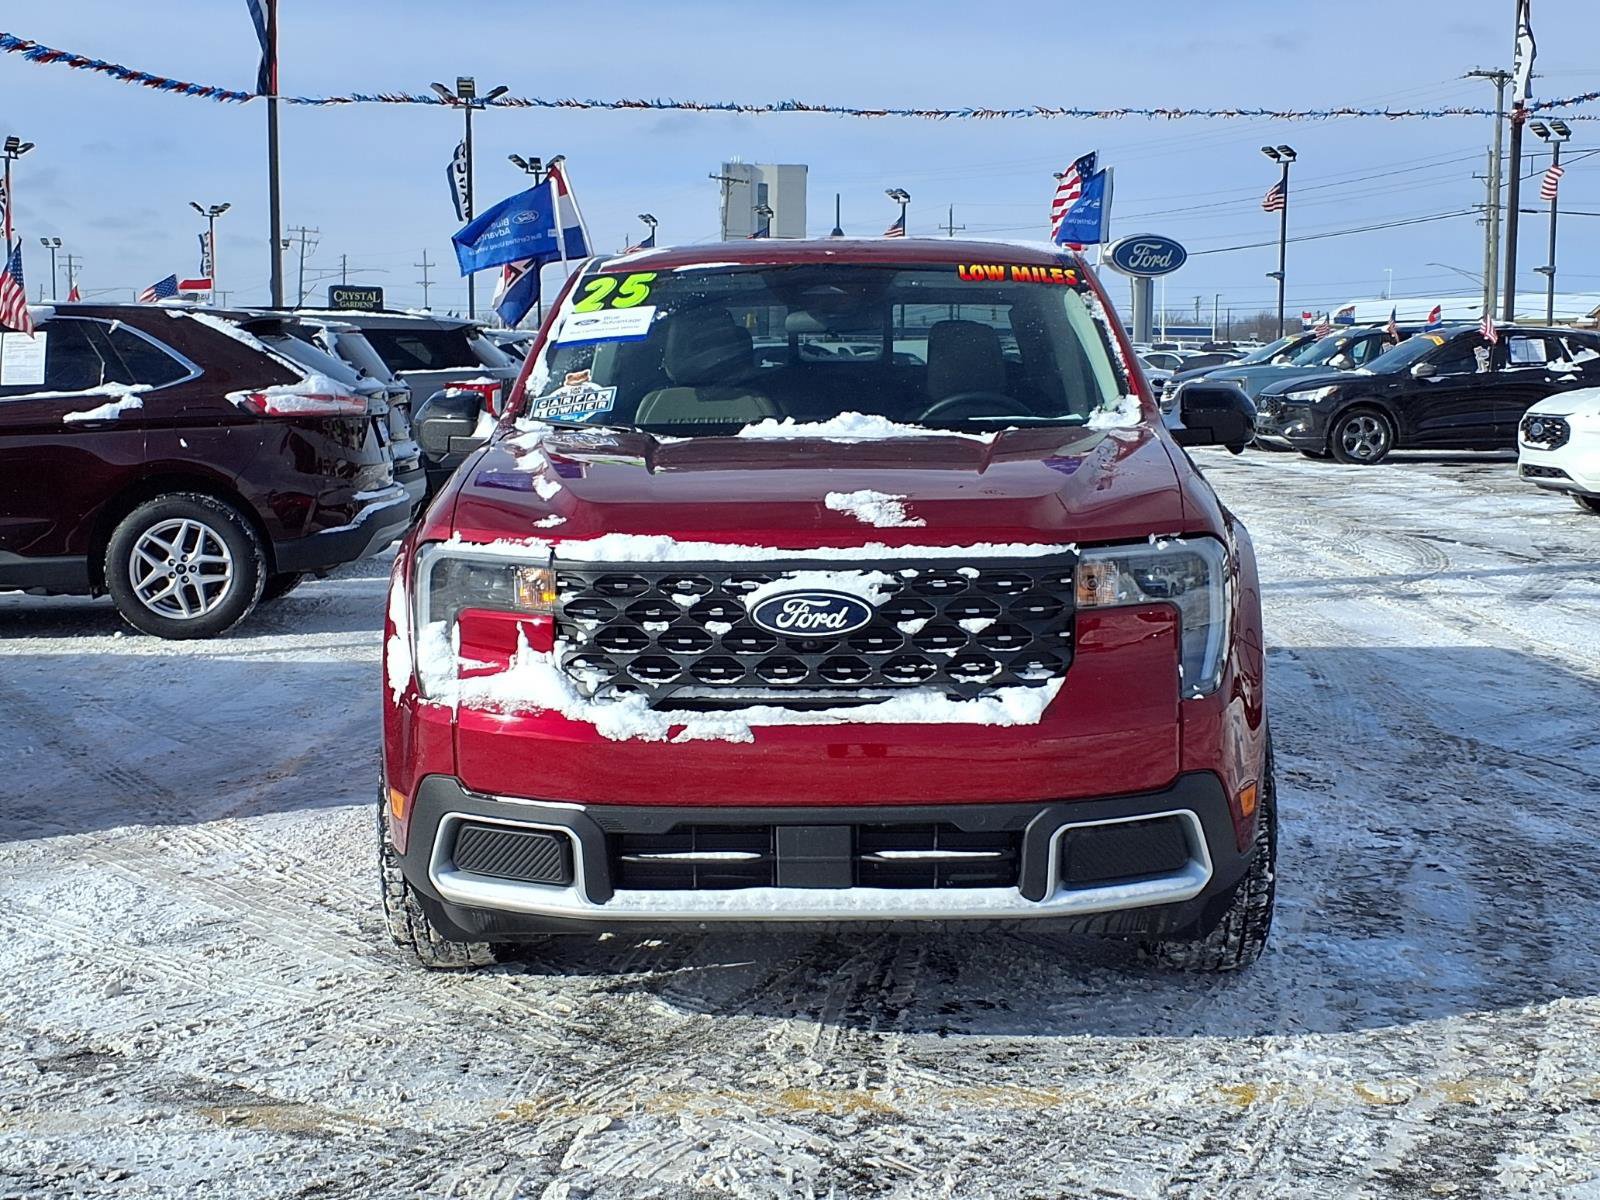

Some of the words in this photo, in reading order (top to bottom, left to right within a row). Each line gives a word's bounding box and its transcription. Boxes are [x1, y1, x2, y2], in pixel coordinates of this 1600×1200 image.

[1128, 243, 1173, 268] Ford
[958, 264, 1005, 281] LOW
[1011, 265, 1078, 285] MILES
[333, 290, 380, 303] CRYSTAL
[574, 272, 657, 313] 25
[340, 301, 374, 309] GARDENS
[538, 392, 609, 410] CARFAX
[548, 401, 607, 416] OWNER
[775, 598, 849, 629] Ford
